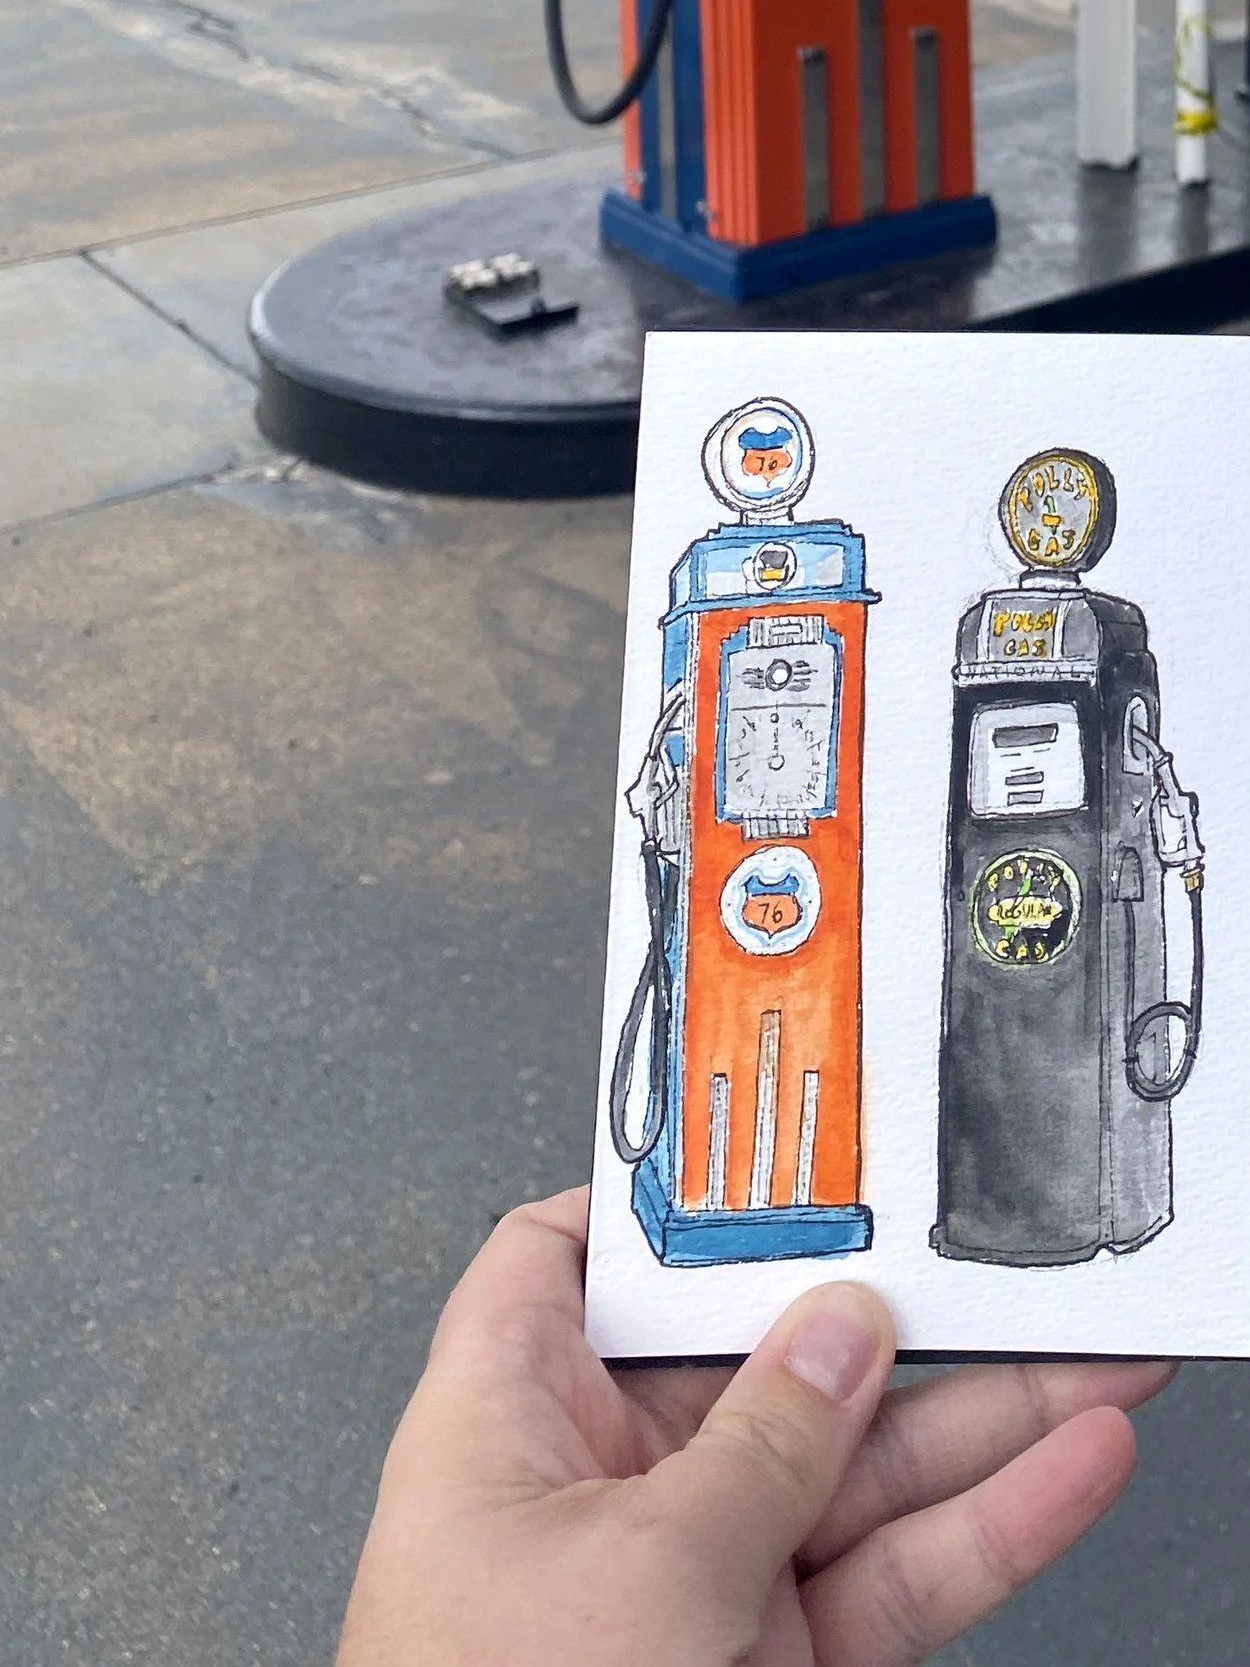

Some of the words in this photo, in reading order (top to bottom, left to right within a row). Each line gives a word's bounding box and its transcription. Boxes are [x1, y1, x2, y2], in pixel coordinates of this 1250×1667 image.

[756, 456, 778, 472] 76
[1027, 528, 1077, 557] GAS
[758, 902, 784, 925] 76
